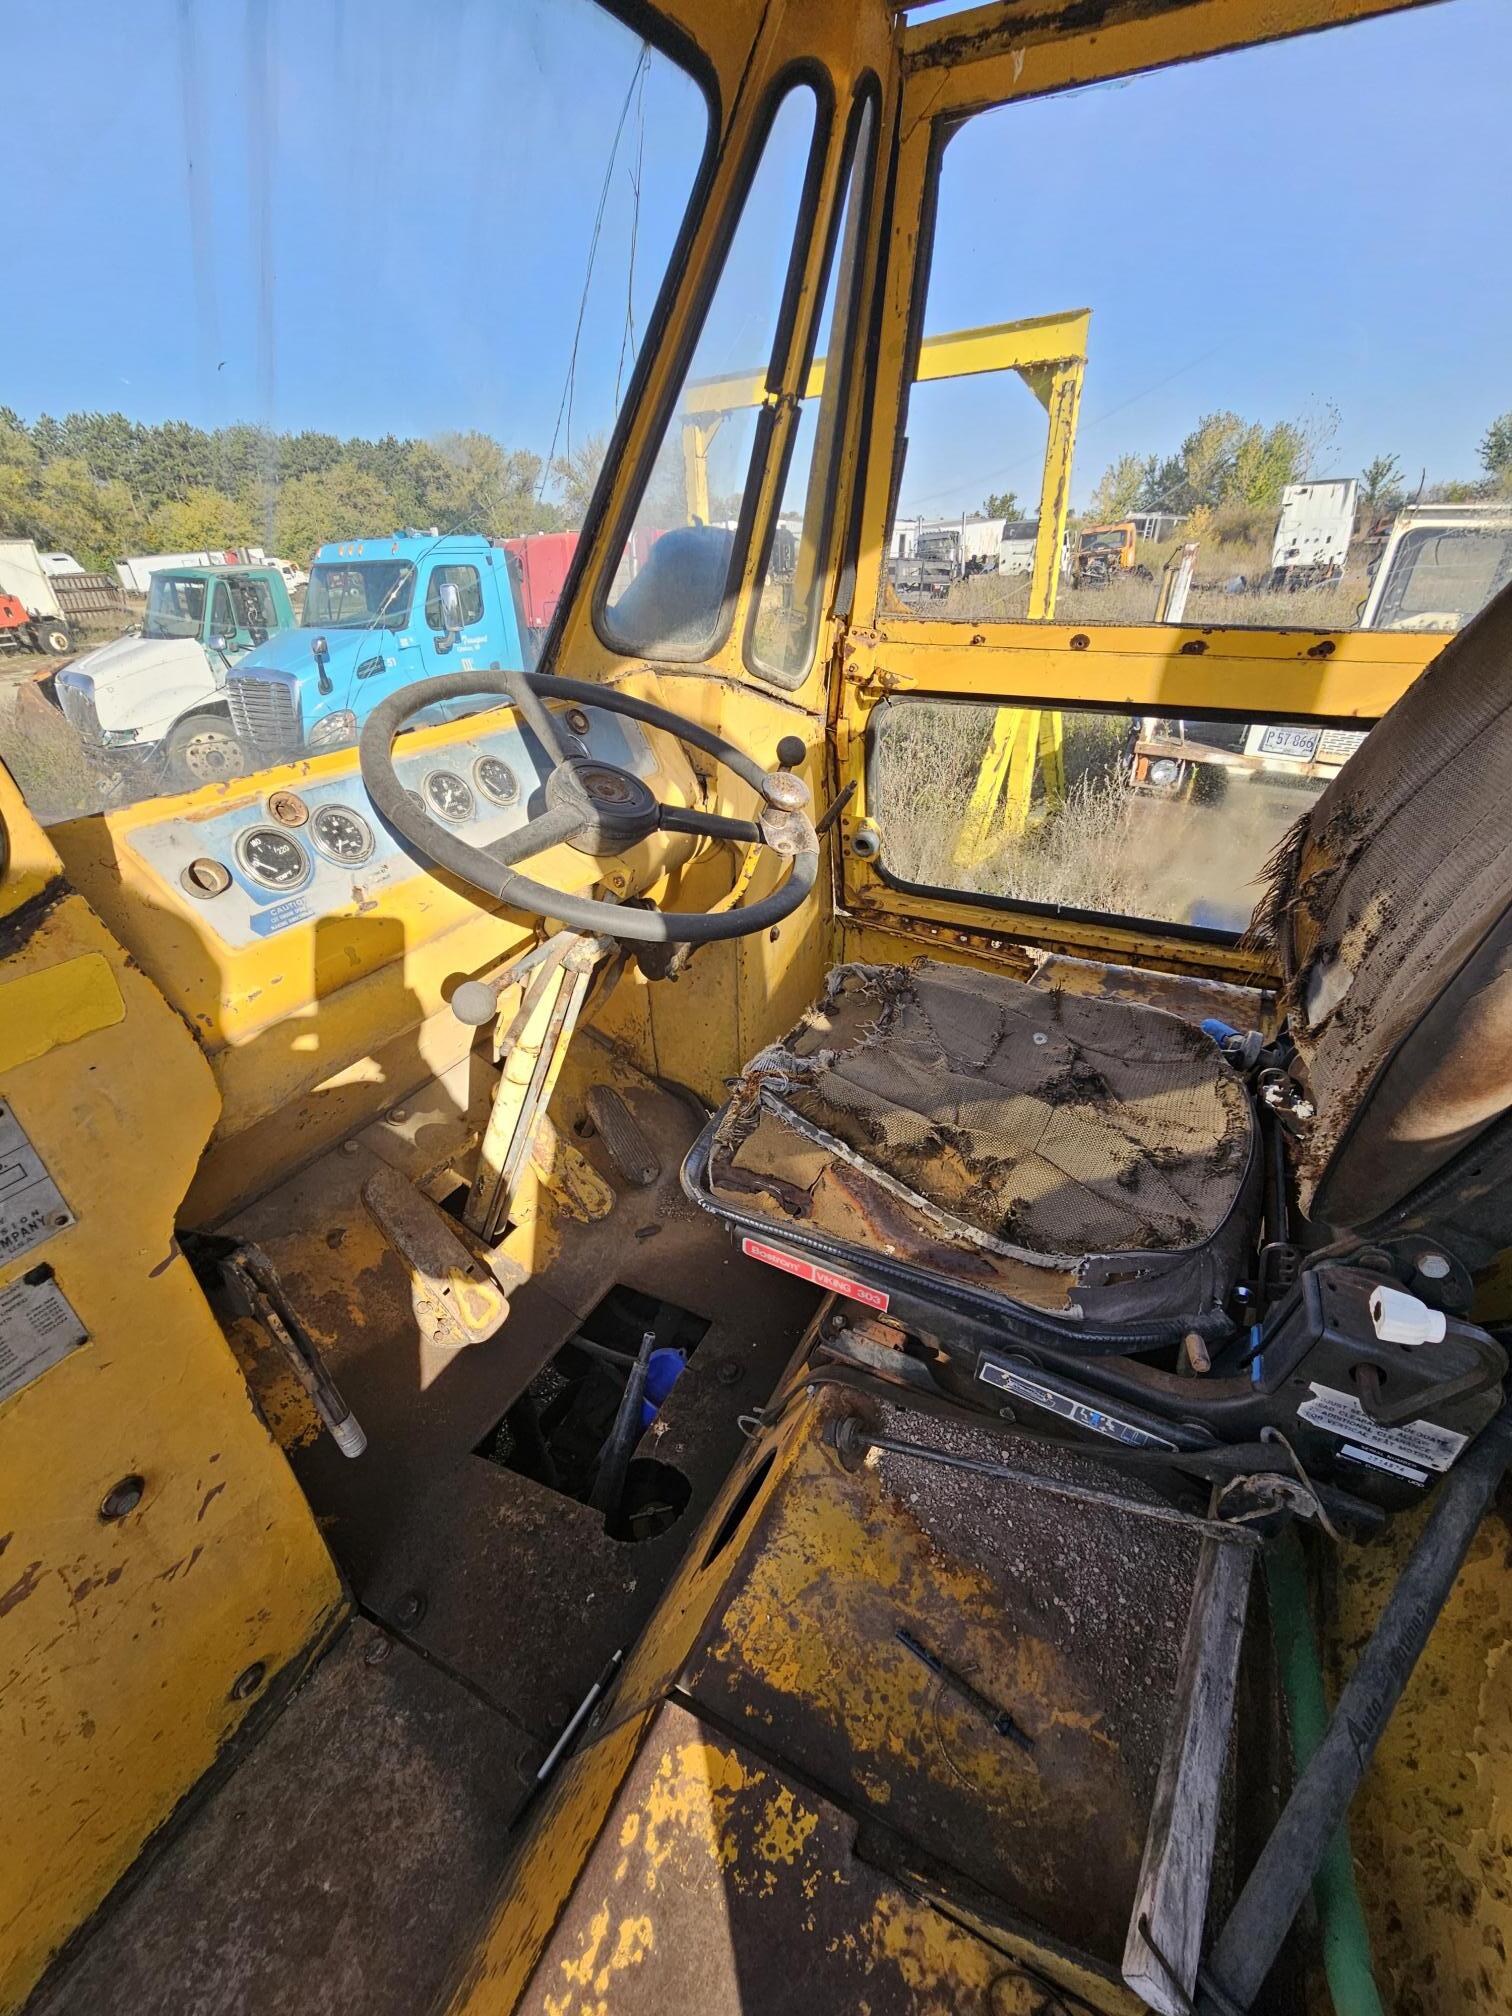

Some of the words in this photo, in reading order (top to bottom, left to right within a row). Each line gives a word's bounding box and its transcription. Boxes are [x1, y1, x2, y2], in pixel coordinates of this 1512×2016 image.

[1276, 732, 1291, 746] 57
[1292, 734, 1314, 749] 866
[277, 845, 290, 855] 220
[750, 1246, 799, 1272] Bostrom
[816, 1271, 851, 1292] VIKING
[857, 1288, 882, 1305] 303
[1321, 1410, 1373, 1434] ADDITIONAL
[1371, 1434, 1394, 1448] SEAT
